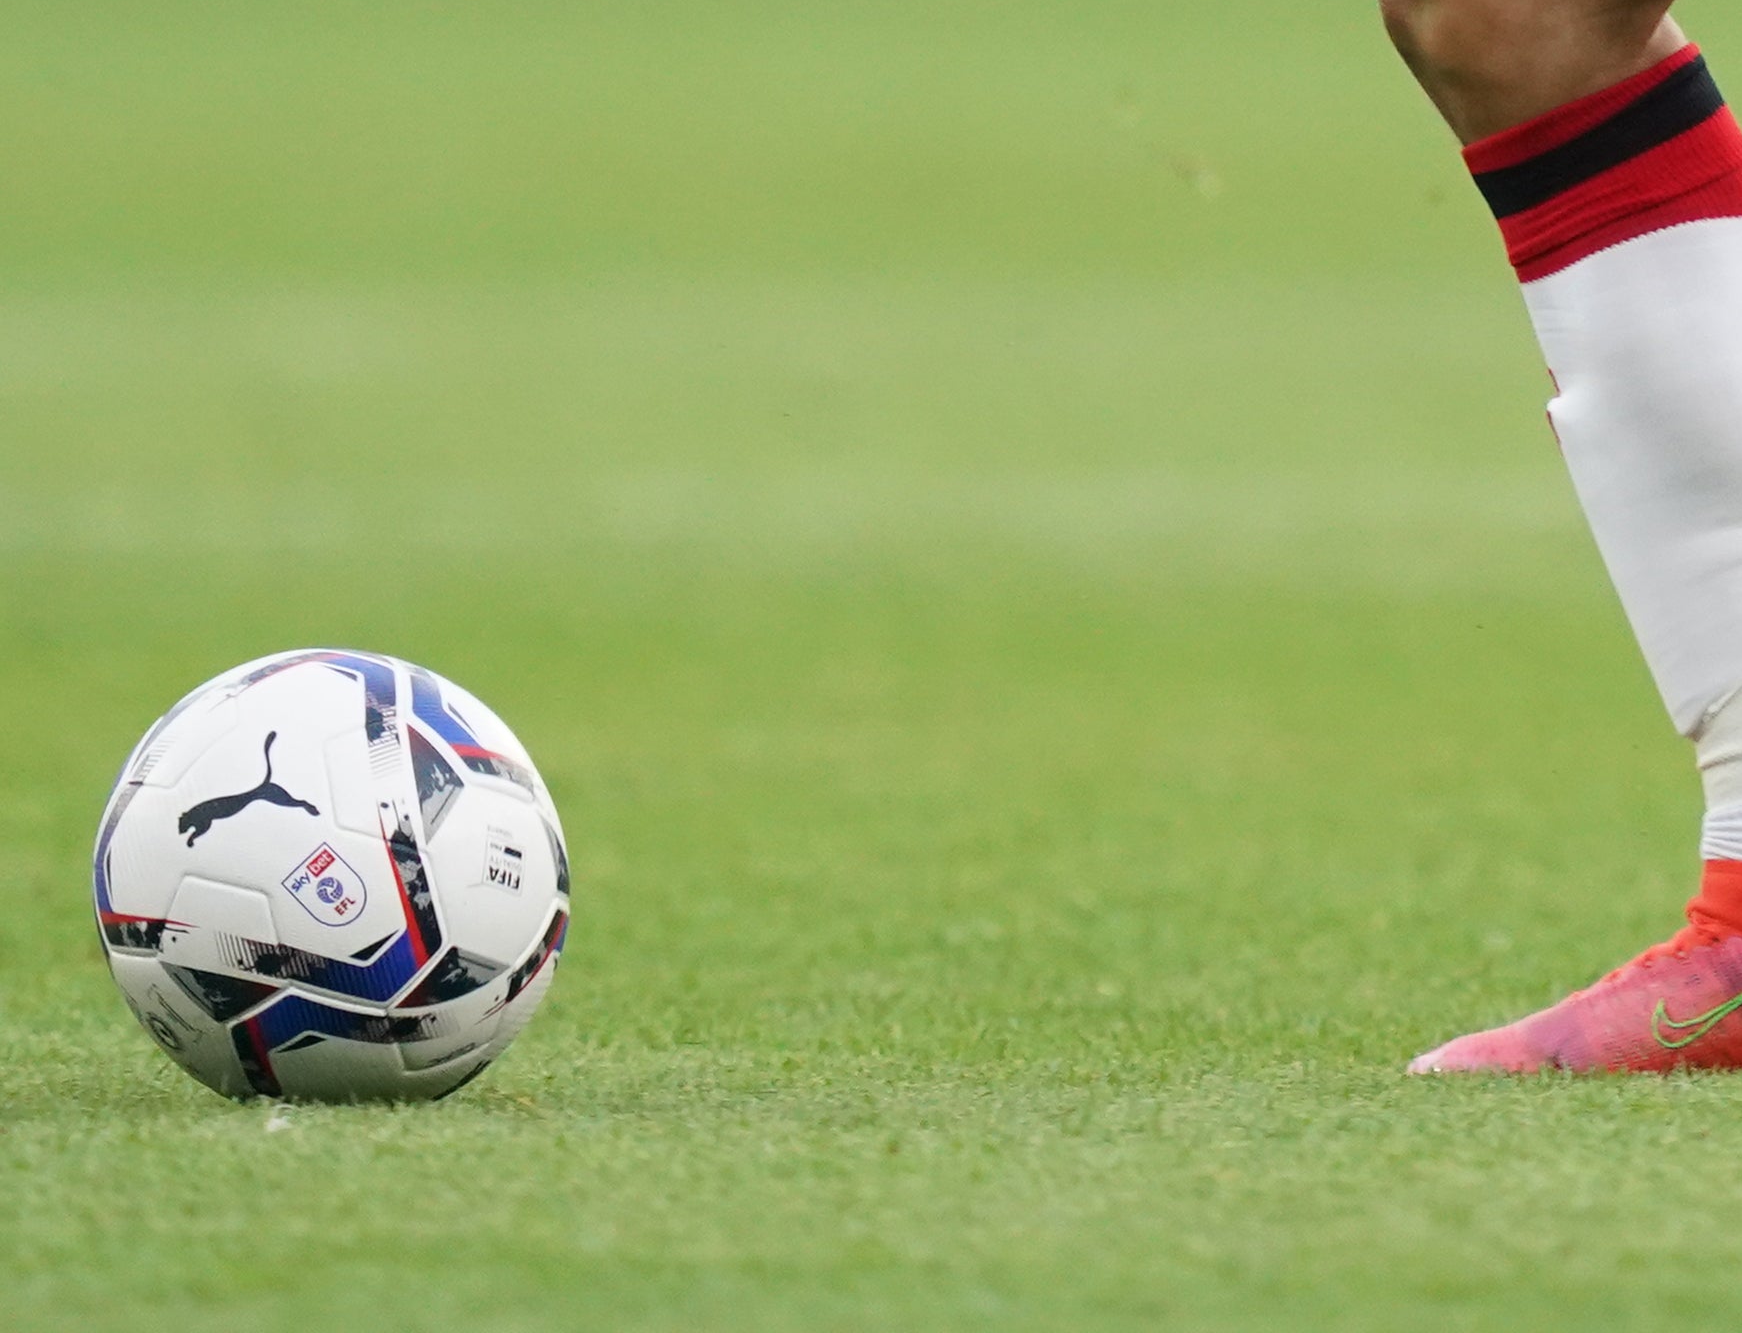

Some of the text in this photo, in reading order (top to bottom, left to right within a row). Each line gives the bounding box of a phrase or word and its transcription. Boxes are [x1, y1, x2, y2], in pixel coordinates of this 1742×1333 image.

[290, 850, 334, 894] sky bet
[488, 865, 521, 890] FIFA
[333, 896, 357, 917] EFL
